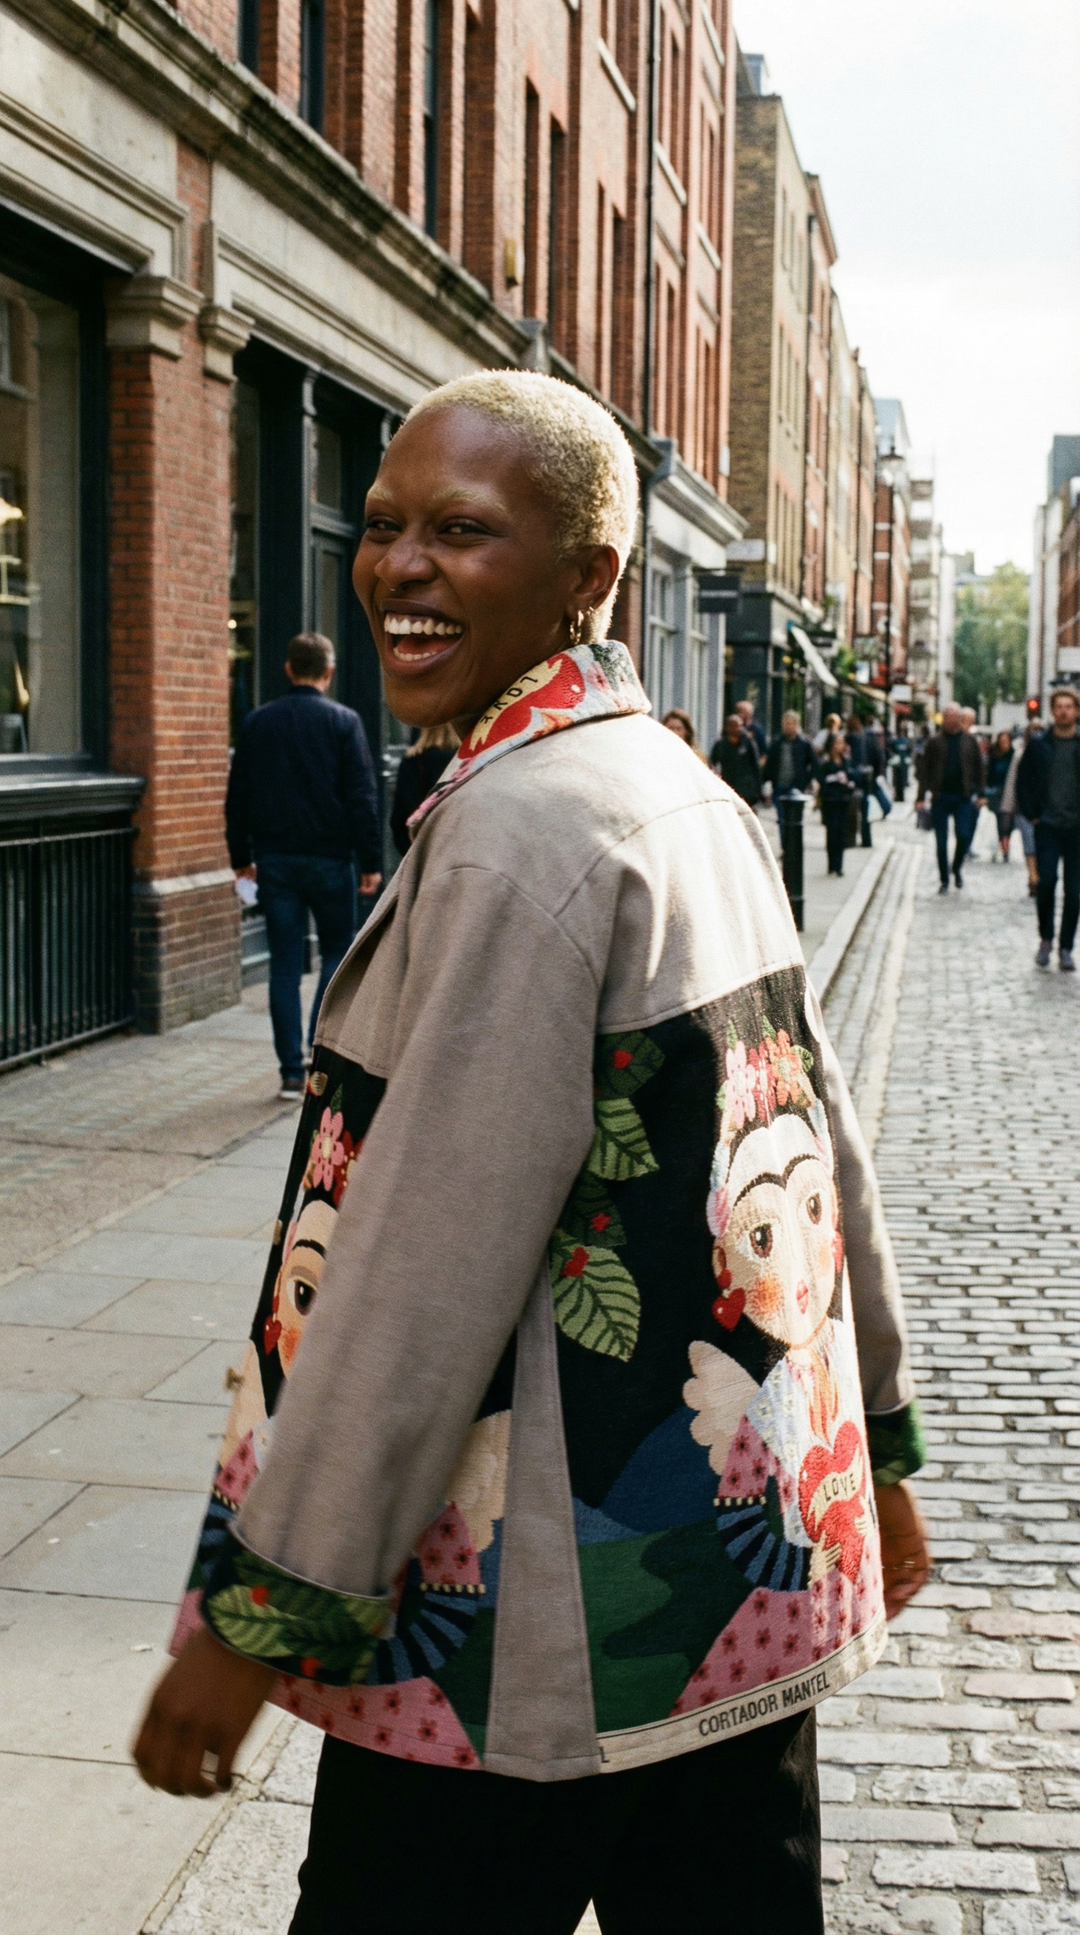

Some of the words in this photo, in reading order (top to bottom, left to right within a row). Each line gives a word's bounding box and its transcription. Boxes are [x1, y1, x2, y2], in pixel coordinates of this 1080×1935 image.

[823, 1473, 856, 1501] LOVE
[699, 1693, 778, 1736] CORTADOR
[782, 1671, 831, 1708] MANTEL
